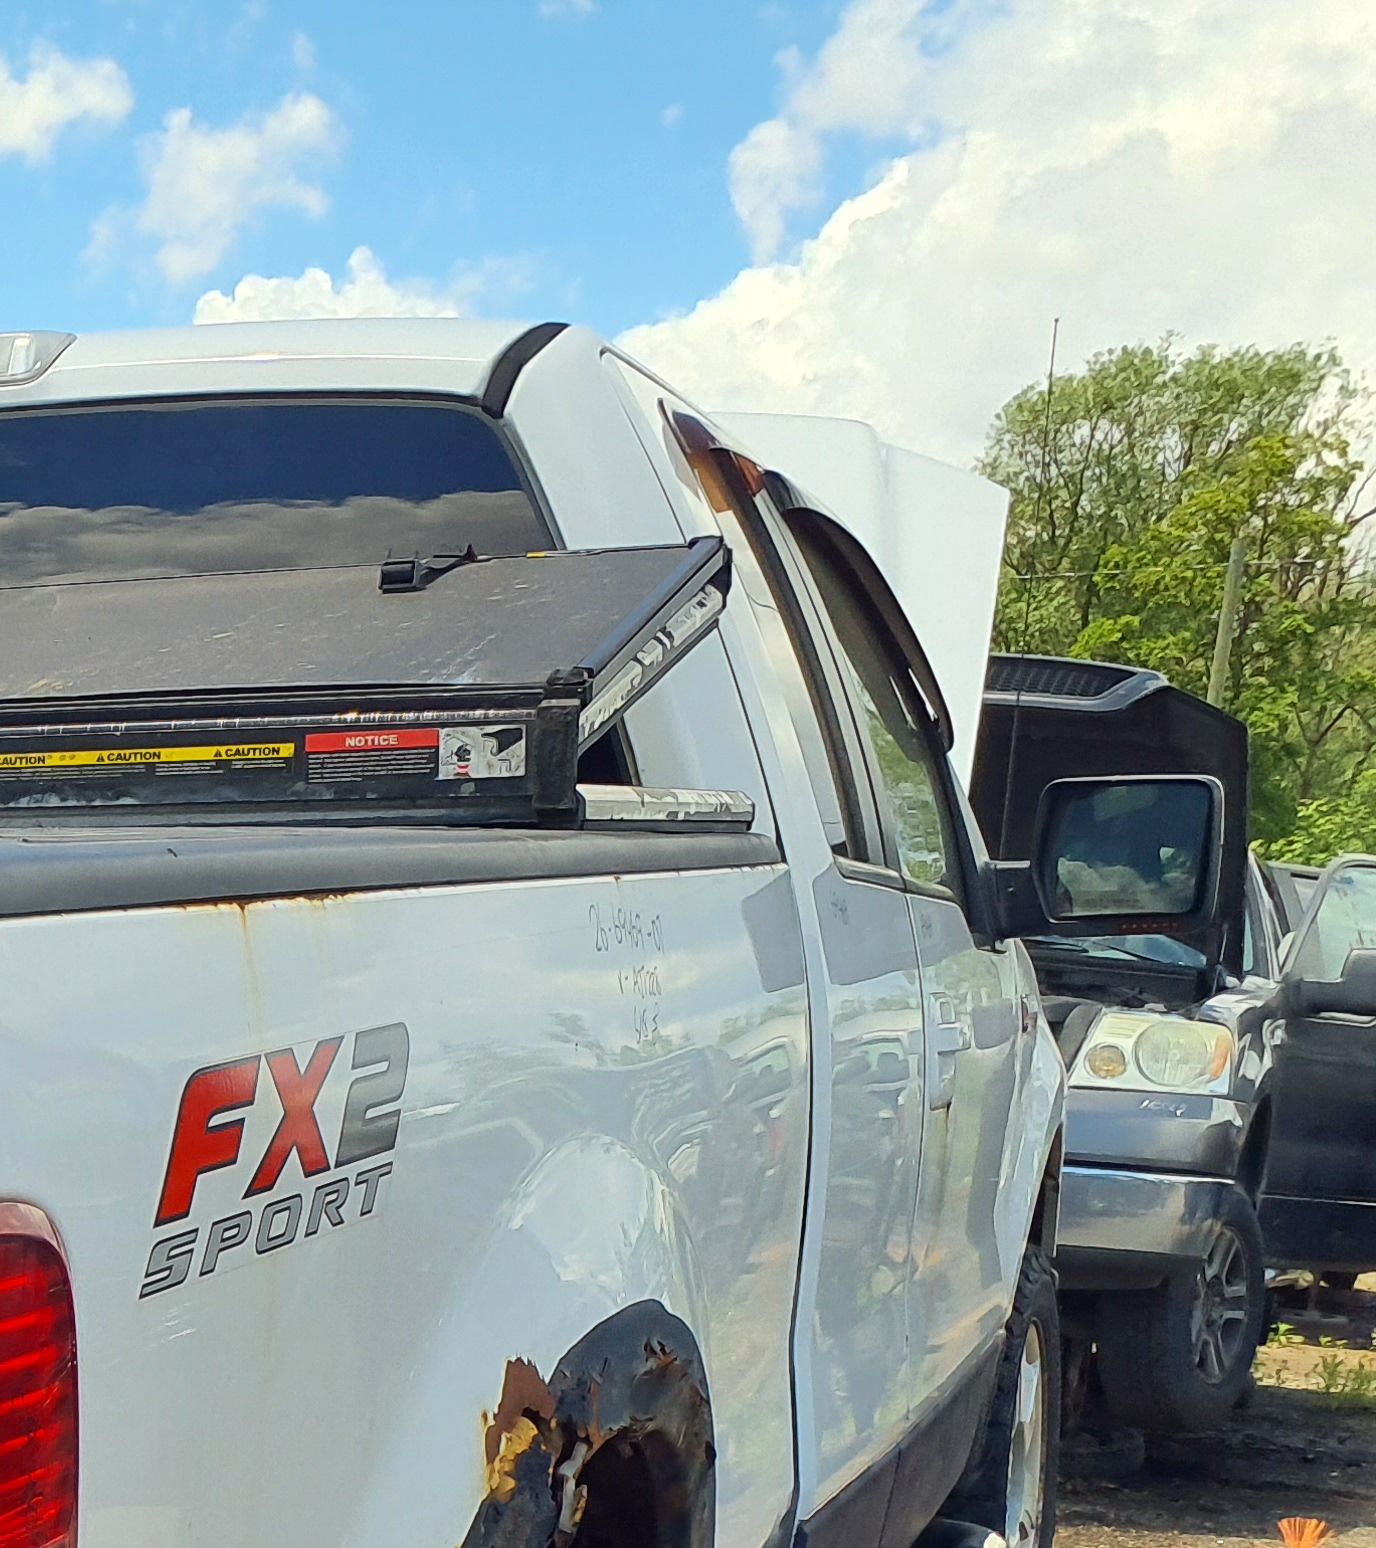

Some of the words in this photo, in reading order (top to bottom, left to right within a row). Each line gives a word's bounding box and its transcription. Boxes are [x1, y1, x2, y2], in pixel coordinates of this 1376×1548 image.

[344, 734, 399, 747] NOTICE
[107, 752, 162, 762] CAUTION
[225, 747, 281, 757] CAUTION
[152, 1021, 410, 1229] FX2
[137, 1160, 394, 1301] SPORT
